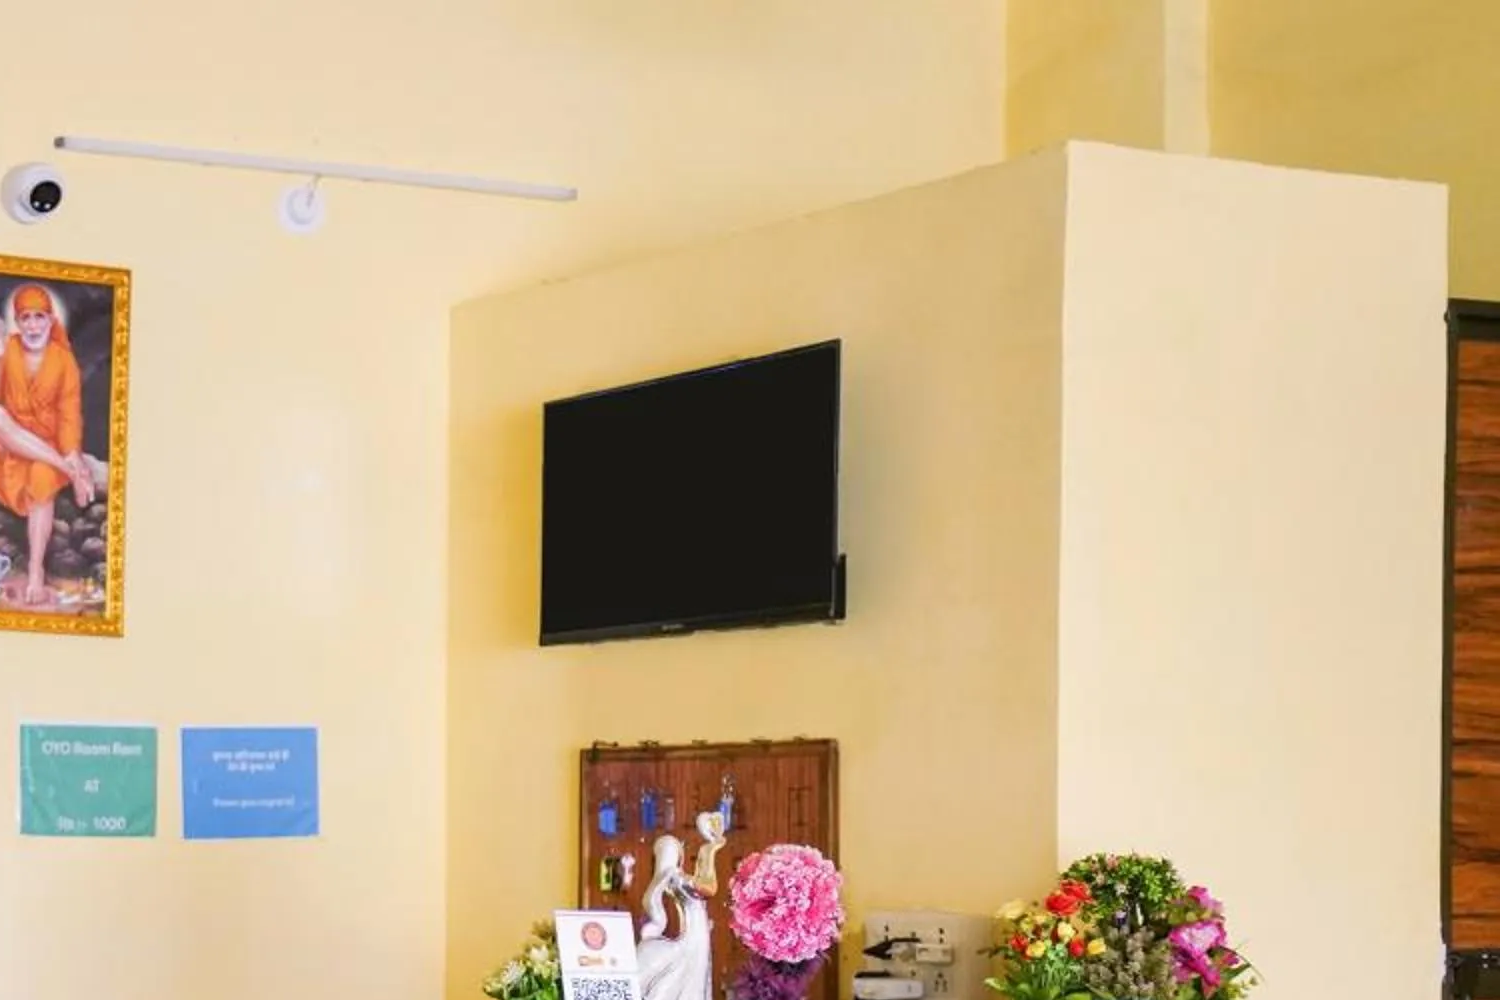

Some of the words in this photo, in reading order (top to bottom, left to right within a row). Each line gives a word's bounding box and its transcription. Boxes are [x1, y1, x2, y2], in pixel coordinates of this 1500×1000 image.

[41, 740, 71, 756] OYO
[73, 741, 111, 756] Room
[83, 778, 100, 793] AT
[93, 816, 127, 831] 1000
